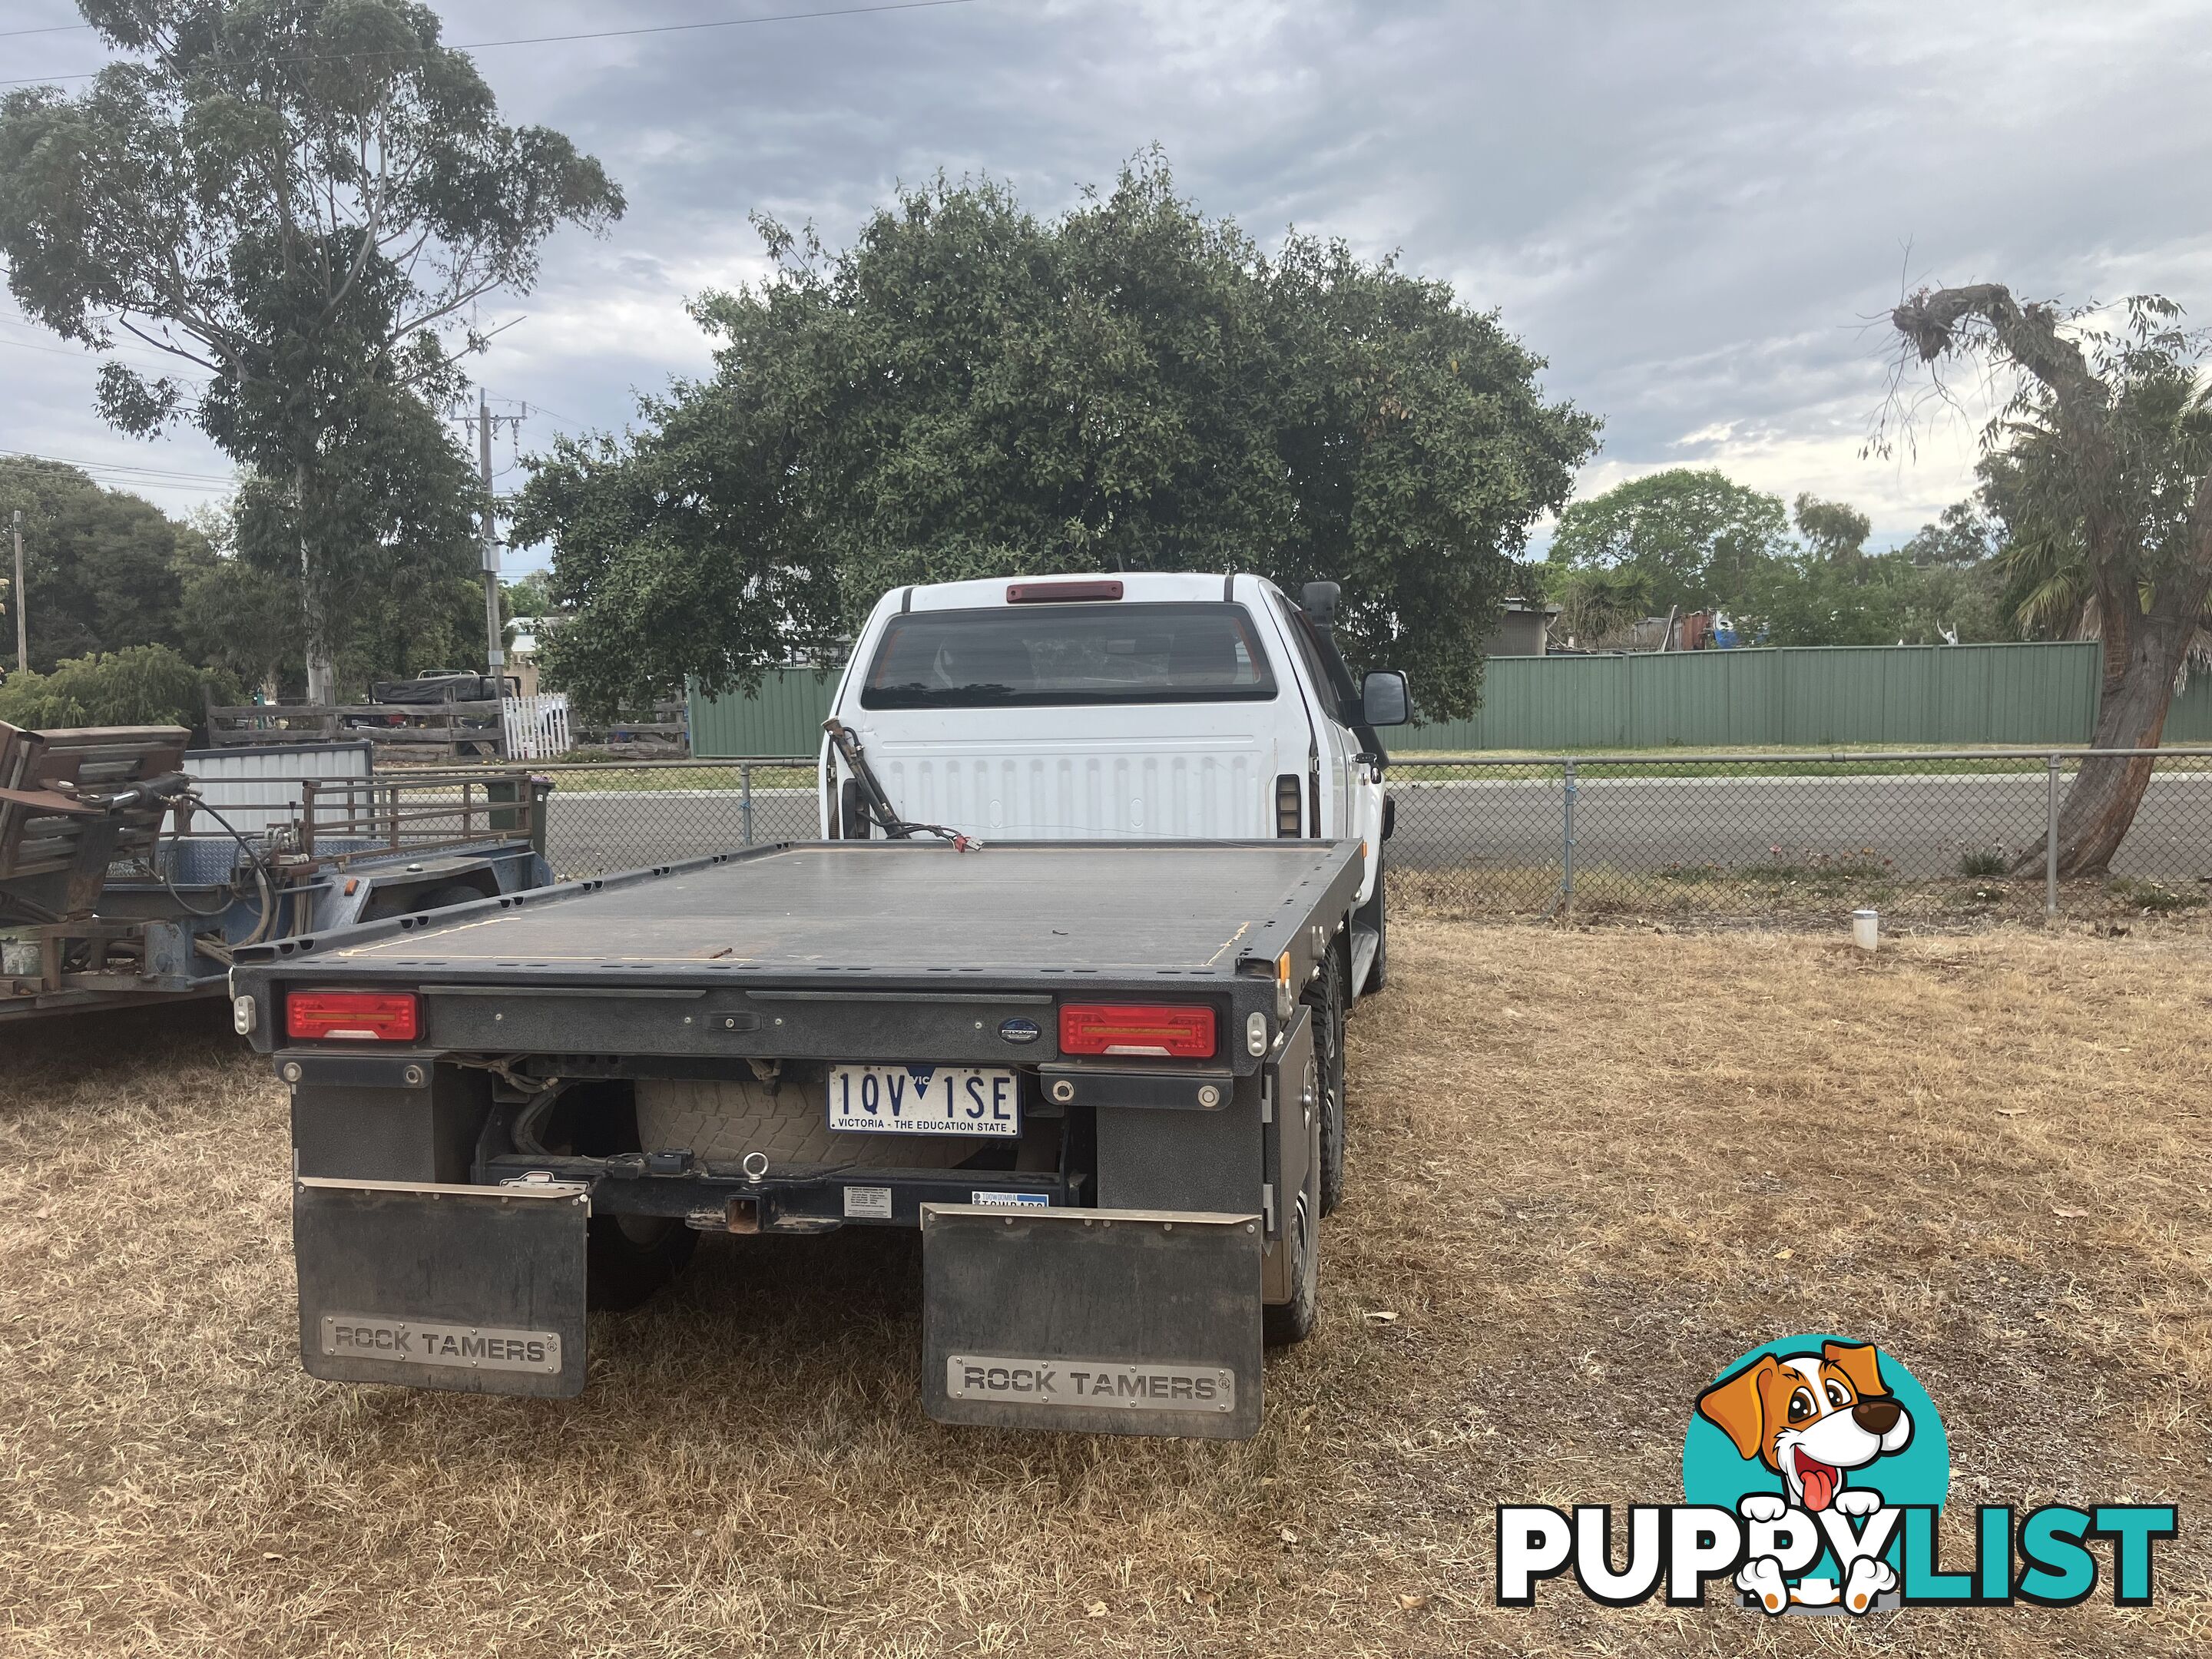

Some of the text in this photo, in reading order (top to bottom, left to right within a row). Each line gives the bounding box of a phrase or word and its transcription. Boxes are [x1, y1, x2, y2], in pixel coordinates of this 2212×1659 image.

[912, 1075, 931, 1085] VIC
[840, 1073, 1011, 1121] 1QV 1SE
[838, 1118, 884, 1128] VICTORIA
[895, 1120, 914, 1129] THE
[917, 1121, 972, 1131] EDUCATION
[977, 1123, 1008, 1132] STATE
[335, 1326, 412, 1353] ROCK
[964, 1366, 1058, 1394] ROCK
